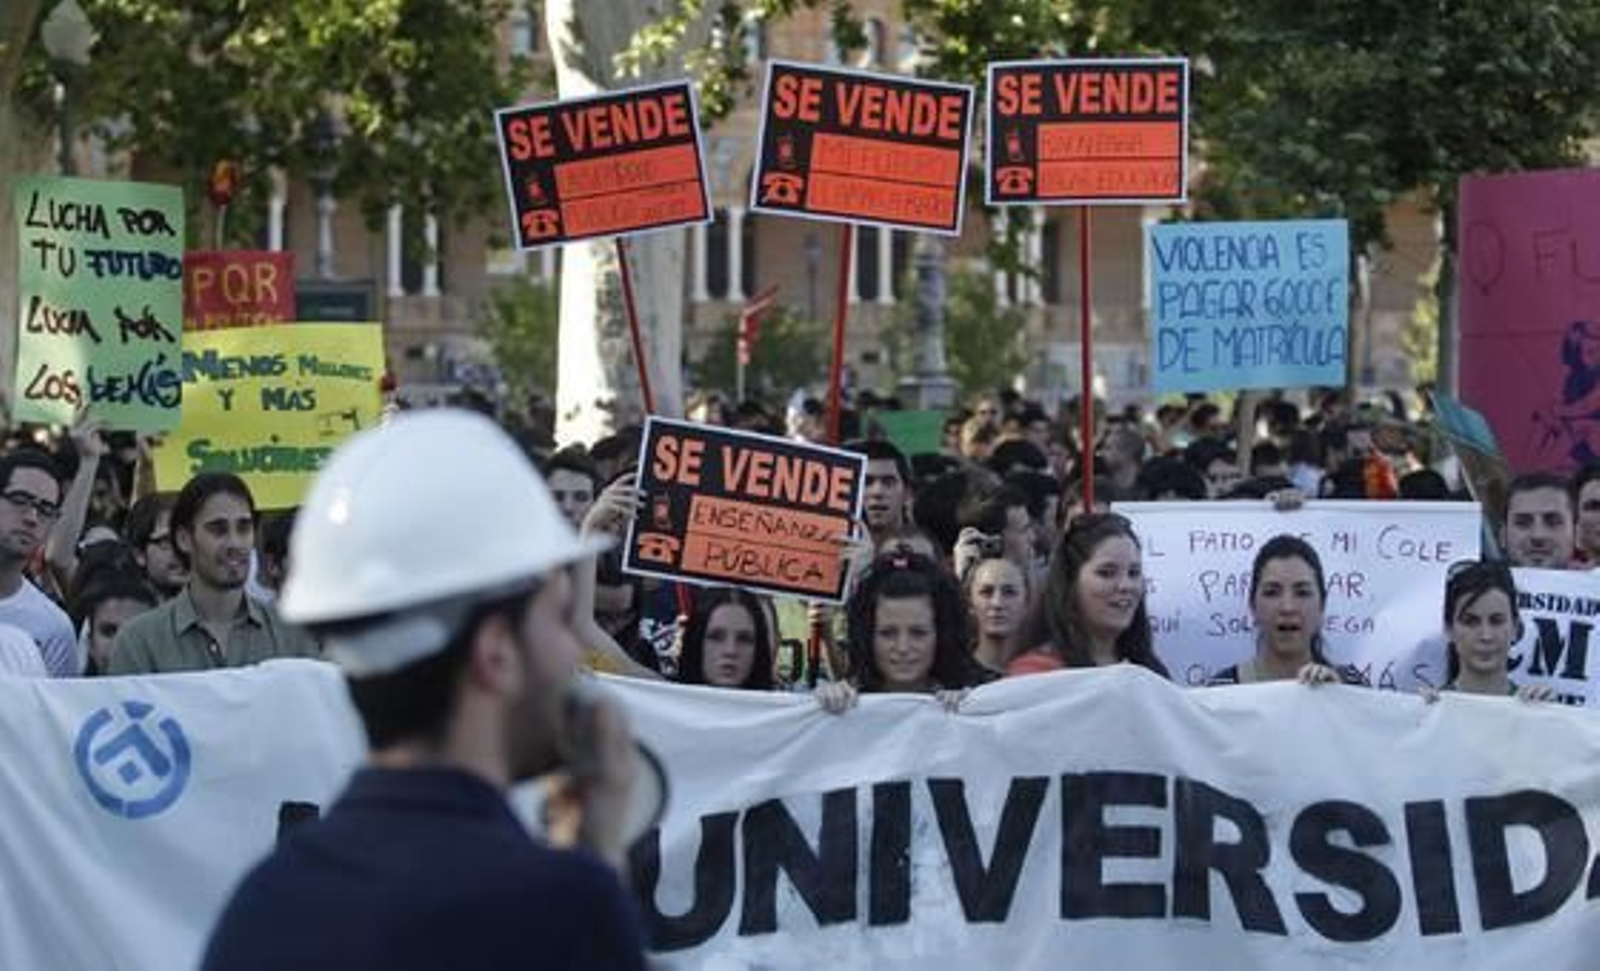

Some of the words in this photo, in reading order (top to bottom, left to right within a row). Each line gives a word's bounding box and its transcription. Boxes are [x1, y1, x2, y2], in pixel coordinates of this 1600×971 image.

[774, 74, 823, 121] SE
[836, 81, 962, 140] VENDE
[998, 74, 1042, 115] SE
[1054, 70, 1179, 114] VENDE
[508, 115, 554, 160] SE
[562, 95, 690, 151] VENDE
[25, 191, 111, 239] LUCHA
[117, 207, 176, 237] POR
[31, 238, 76, 278] TU
[1152, 233, 1280, 273] VIOLENCIA
[1296, 232, 1326, 270] ES
[1159, 279, 1256, 320] PAGAR
[1159, 326, 1202, 373] DE
[218, 388, 234, 411] Y
[653, 435, 705, 486] SE
[722, 447, 854, 511] VENDE
[703, 542, 824, 583] PÚBLICA
[1189, 530, 1254, 553] PATIO
[1331, 533, 1358, 552] MI
[1377, 524, 1451, 562] COLE
[1206, 612, 1254, 636] SOL
[630, 771, 1600, 953] UNIVERSID
